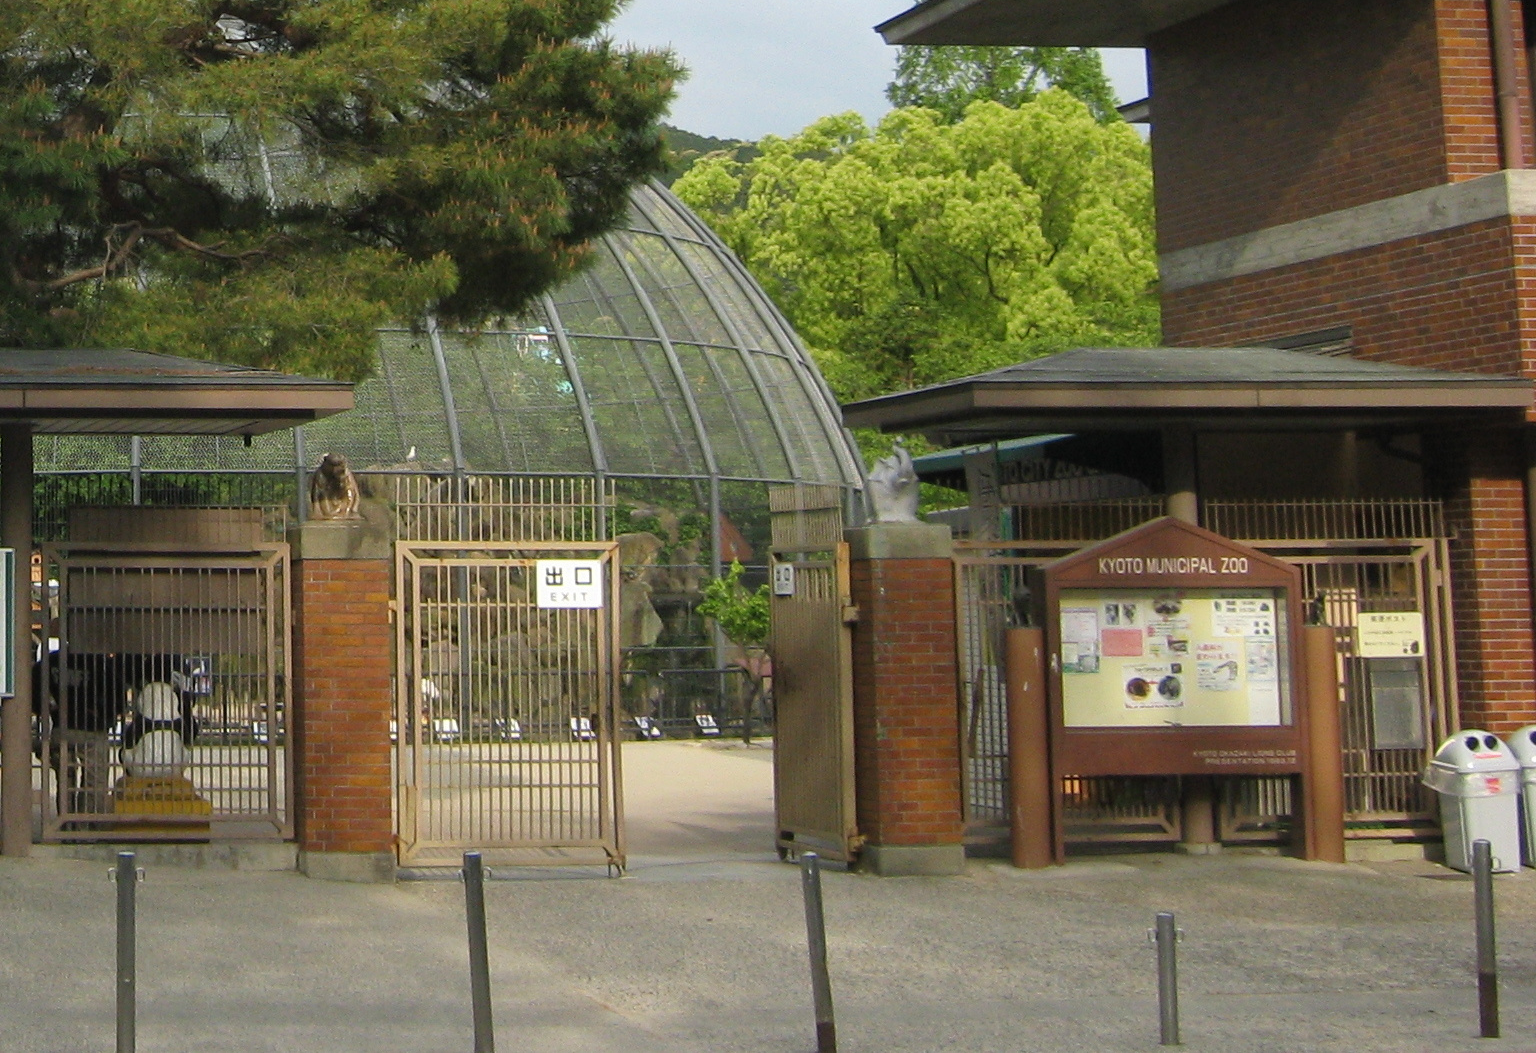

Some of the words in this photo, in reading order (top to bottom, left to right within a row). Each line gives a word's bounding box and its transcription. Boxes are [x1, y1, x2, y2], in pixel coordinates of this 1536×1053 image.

[1098, 557, 1143, 574] KYOTO
[1146, 557, 1216, 574] MUNICIPAL
[1220, 557, 1248, 574] ZOO
[545, 566, 593, 586] 出口
[550, 592, 588, 602] EXIT
